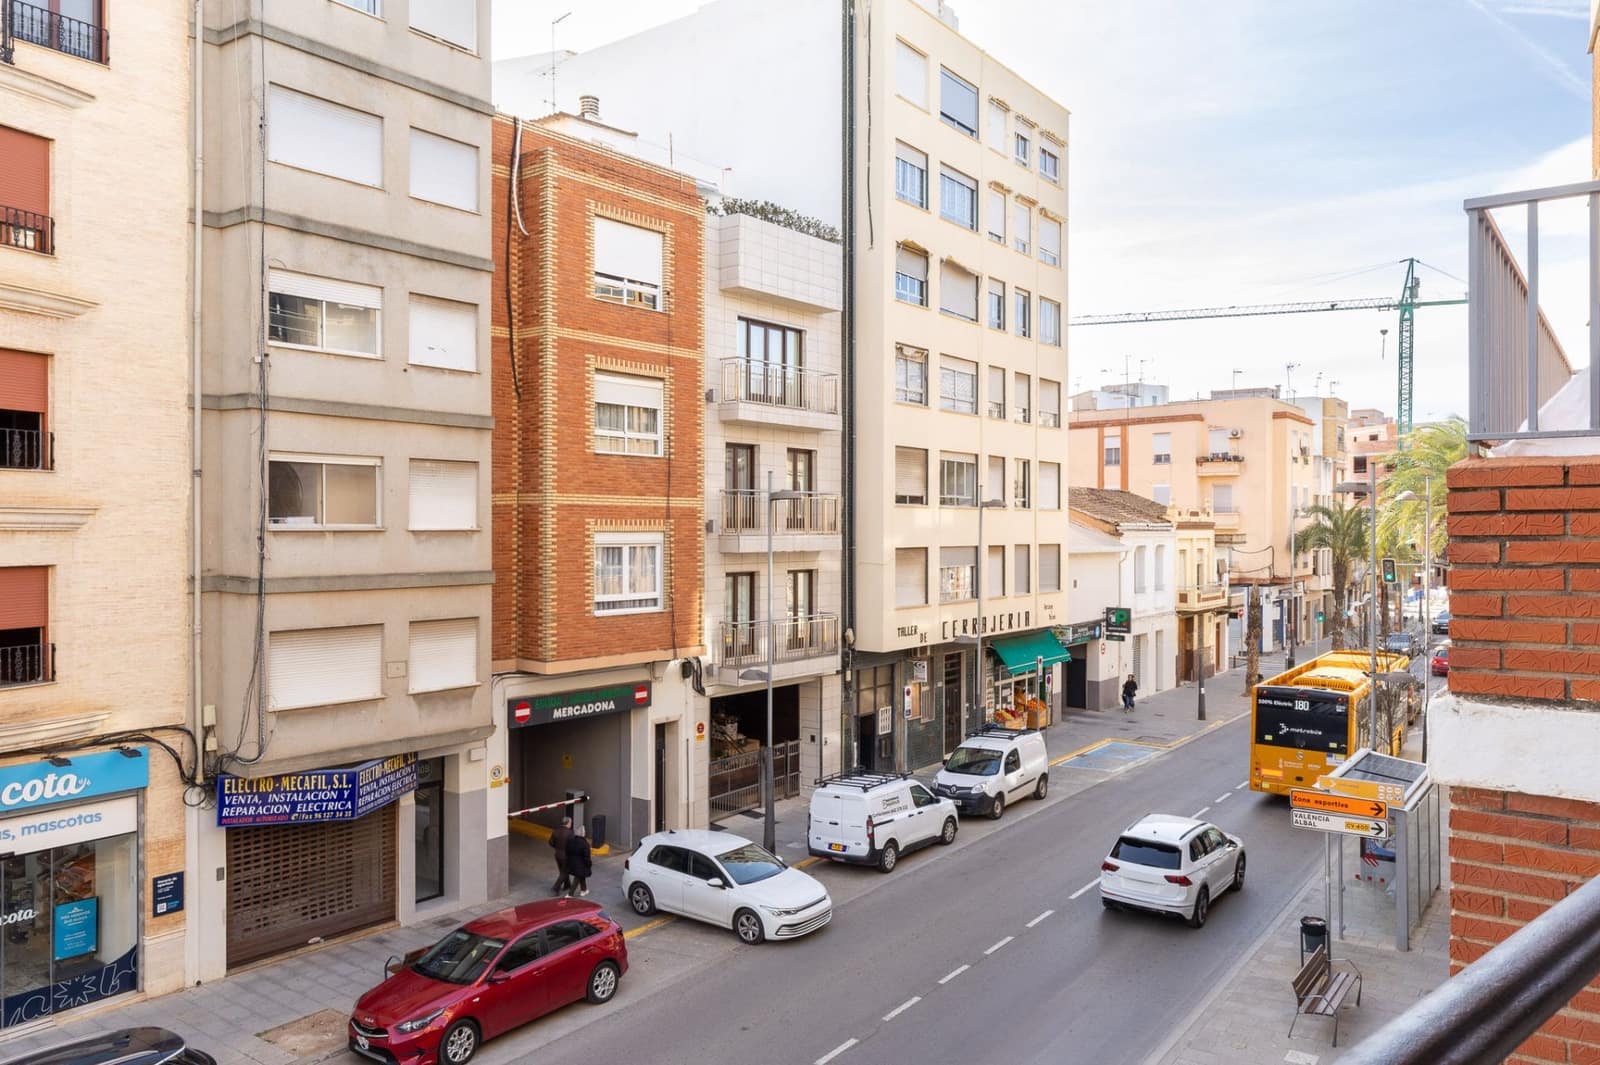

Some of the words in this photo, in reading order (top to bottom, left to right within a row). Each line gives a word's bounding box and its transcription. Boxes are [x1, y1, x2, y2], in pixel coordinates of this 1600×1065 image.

[897, 624, 918, 637] TALLER
[919, 632, 928, 643] DE
[942, 610, 1030, 640] CERRAJERIA
[552, 700, 615, 719] MERCADONA
[1295, 700, 1310, 711] 180
[332, 774, 352, 789] S.L.
[224, 794, 262, 805] VENTA,
[343, 789, 350, 799] Y
[222, 803, 291, 817] REPARACION
[297, 801, 352, 813] ELECTRICA
[21, 812, 103, 836] mascotas
[1294, 819, 1317, 827] ALBAL
